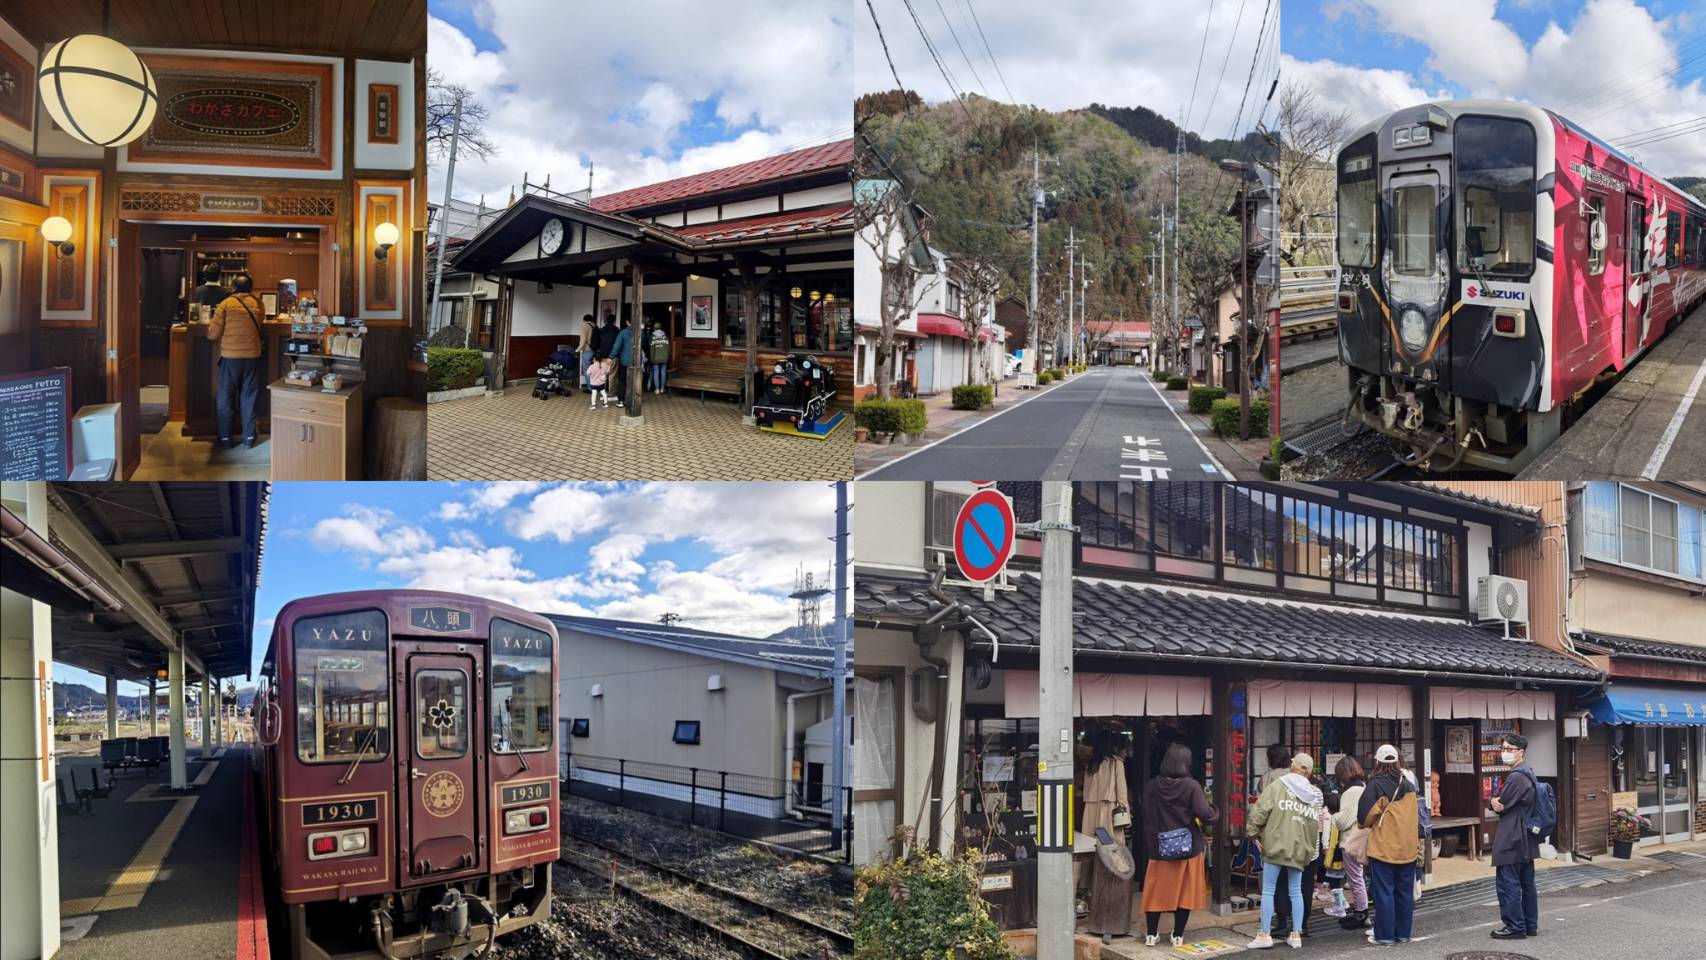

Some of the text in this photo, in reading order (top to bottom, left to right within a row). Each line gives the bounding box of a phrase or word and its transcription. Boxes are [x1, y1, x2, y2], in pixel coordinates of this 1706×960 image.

[188, 102, 277, 118] わかさカフェ
[422, 609, 460, 626] 八頭
[313, 628, 372, 641] YAZU
[504, 637, 542, 649] YAZU
[512, 786, 542, 800] 1930
[317, 804, 363, 820] 1930
[1279, 800, 1319, 821] CROWN
[303, 866, 377, 880] WAKASA RAILWAY
